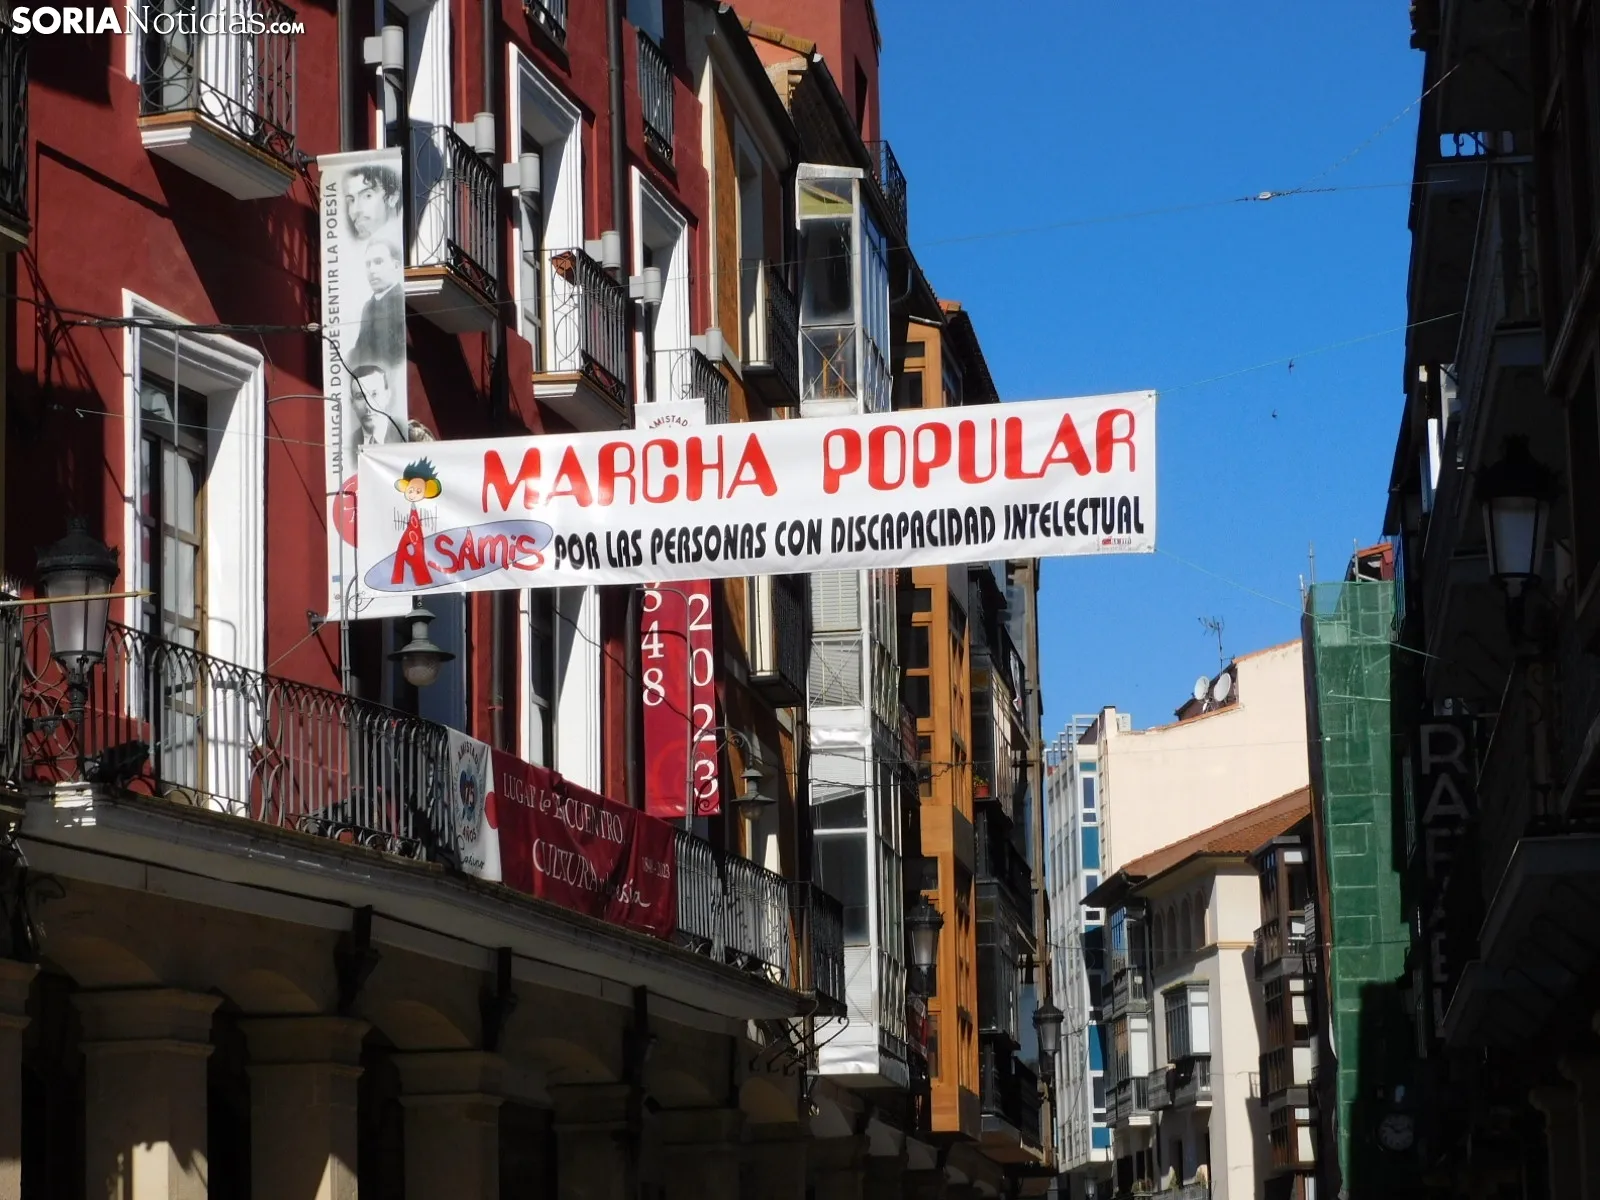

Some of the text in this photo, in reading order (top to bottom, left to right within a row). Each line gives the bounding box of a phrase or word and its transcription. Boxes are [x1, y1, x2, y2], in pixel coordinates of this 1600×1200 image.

[324, 182, 338, 239] POESÍA
[327, 244, 339, 264] LA
[328, 269, 340, 325] SENTIR
[329, 328, 341, 387] DONDE
[331, 392, 342, 448] LUGAR
[481, 408, 1136, 513] MARCHA POPULAR
[553, 495, 1145, 571] POR LAS PERSONAS CON DISCAPACIDAD INTELECTUAL
[688, 593, 719, 799] 2023
